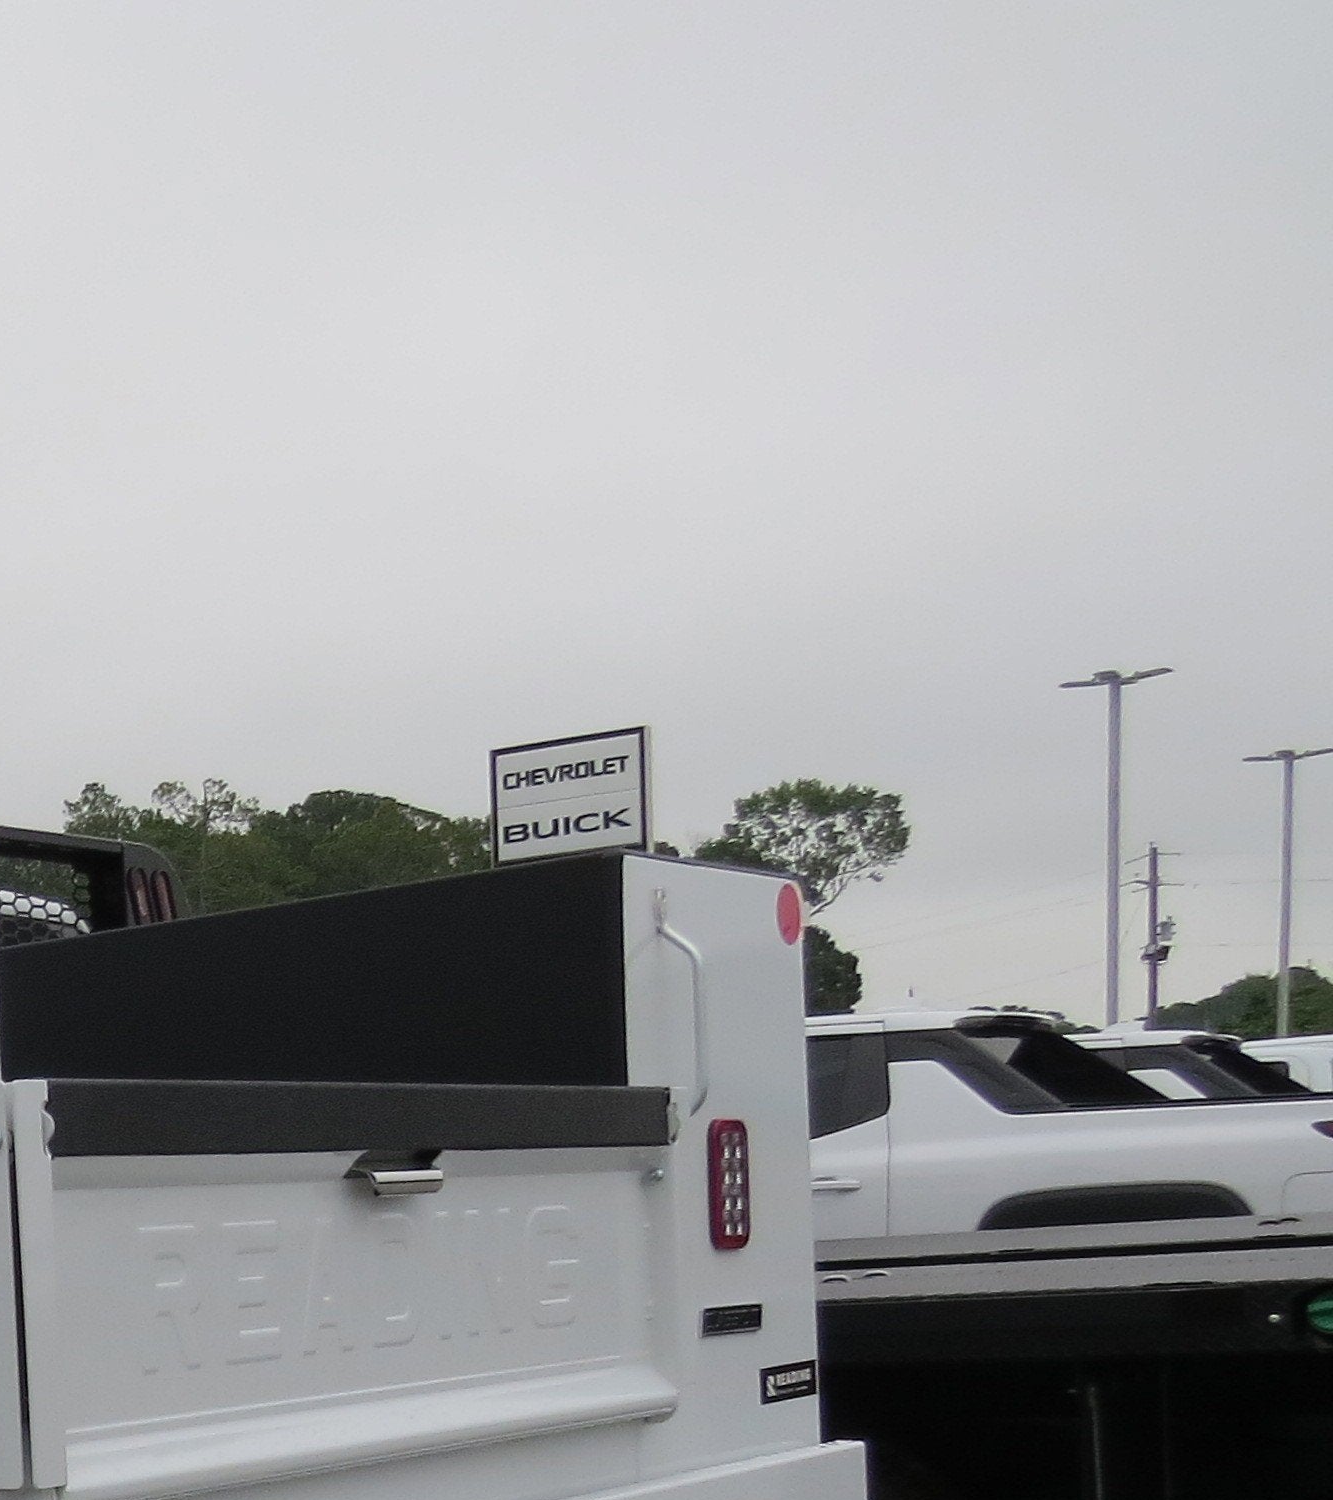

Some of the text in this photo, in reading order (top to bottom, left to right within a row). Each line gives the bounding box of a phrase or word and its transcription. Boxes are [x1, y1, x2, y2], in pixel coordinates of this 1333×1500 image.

[502, 755, 630, 791] CHEVROLET
[502, 807, 632, 845] BUICK
[136, 1203, 581, 1376] READING
